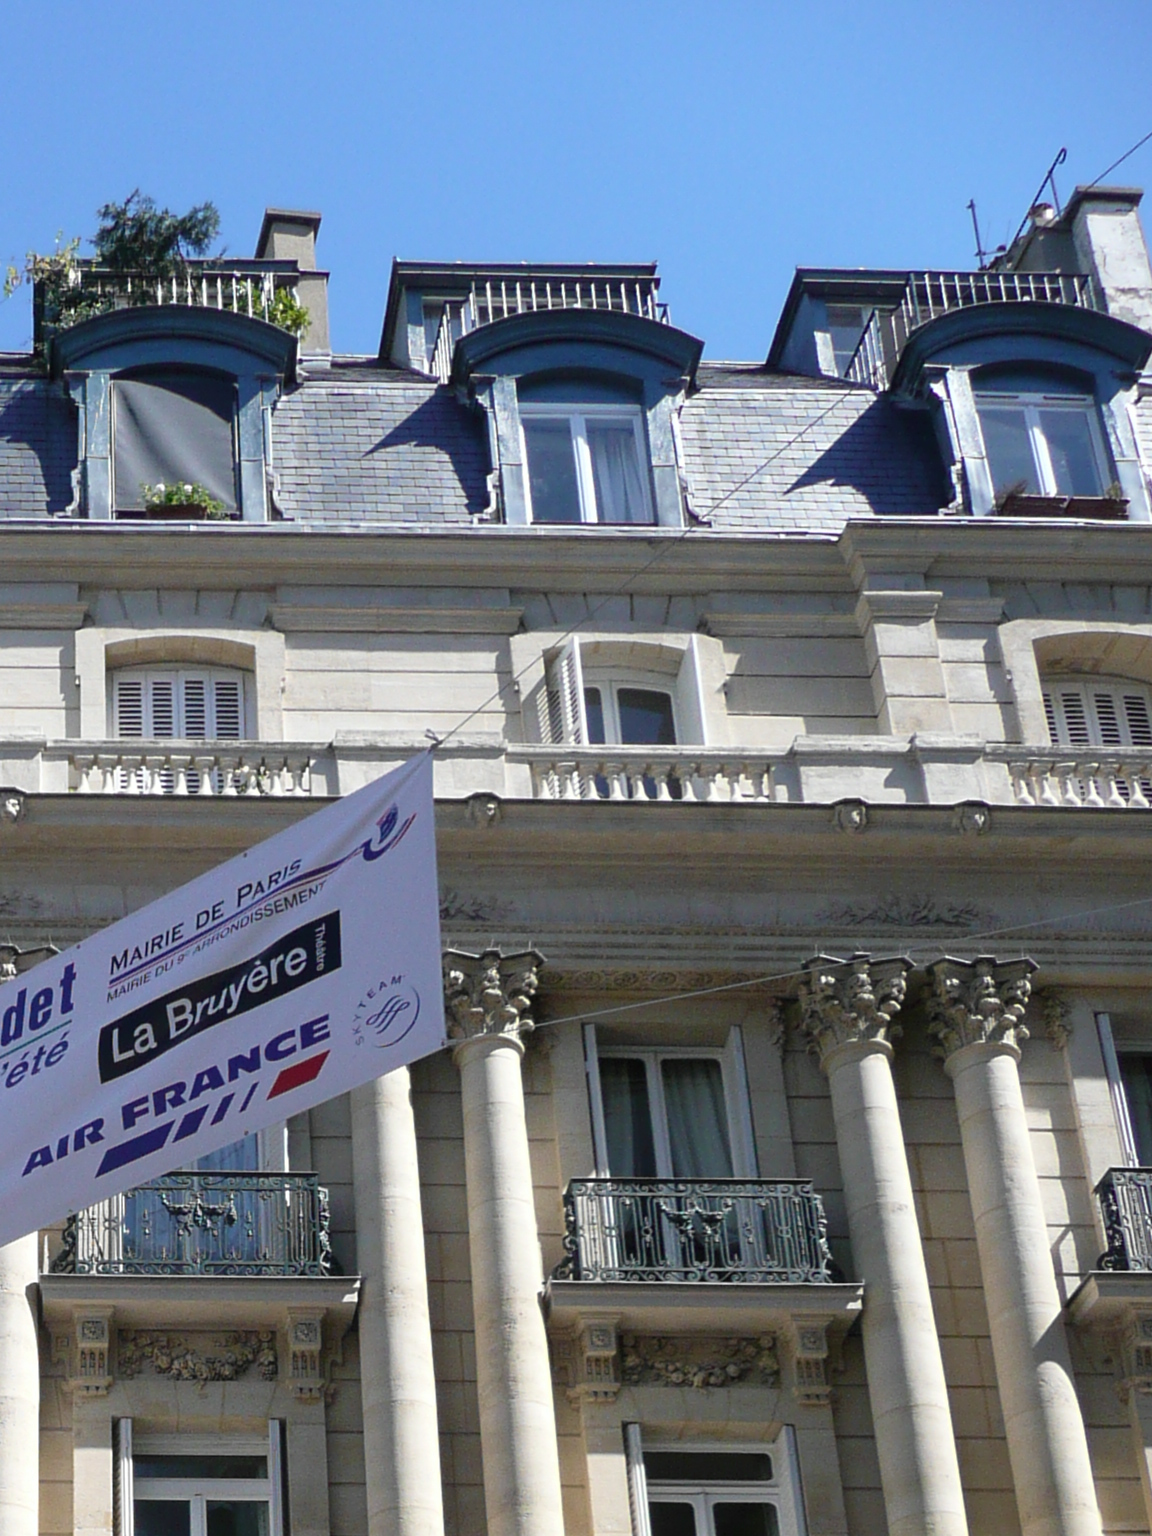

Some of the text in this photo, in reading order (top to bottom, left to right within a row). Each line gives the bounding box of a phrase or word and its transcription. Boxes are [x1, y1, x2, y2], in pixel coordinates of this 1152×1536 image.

[107, 975, 152, 1003] MAIRIE
[155, 960, 174, 978] DU
[195, 880, 327, 954] ARRONDISSEMENT
[110, 859, 303, 975] MAIRIE DE PARIS
[314, 922, 327, 972] Théâtre
[112, 946, 308, 1063] La Bruyère
[21, 1013, 332, 1178] AIR FRANCE
